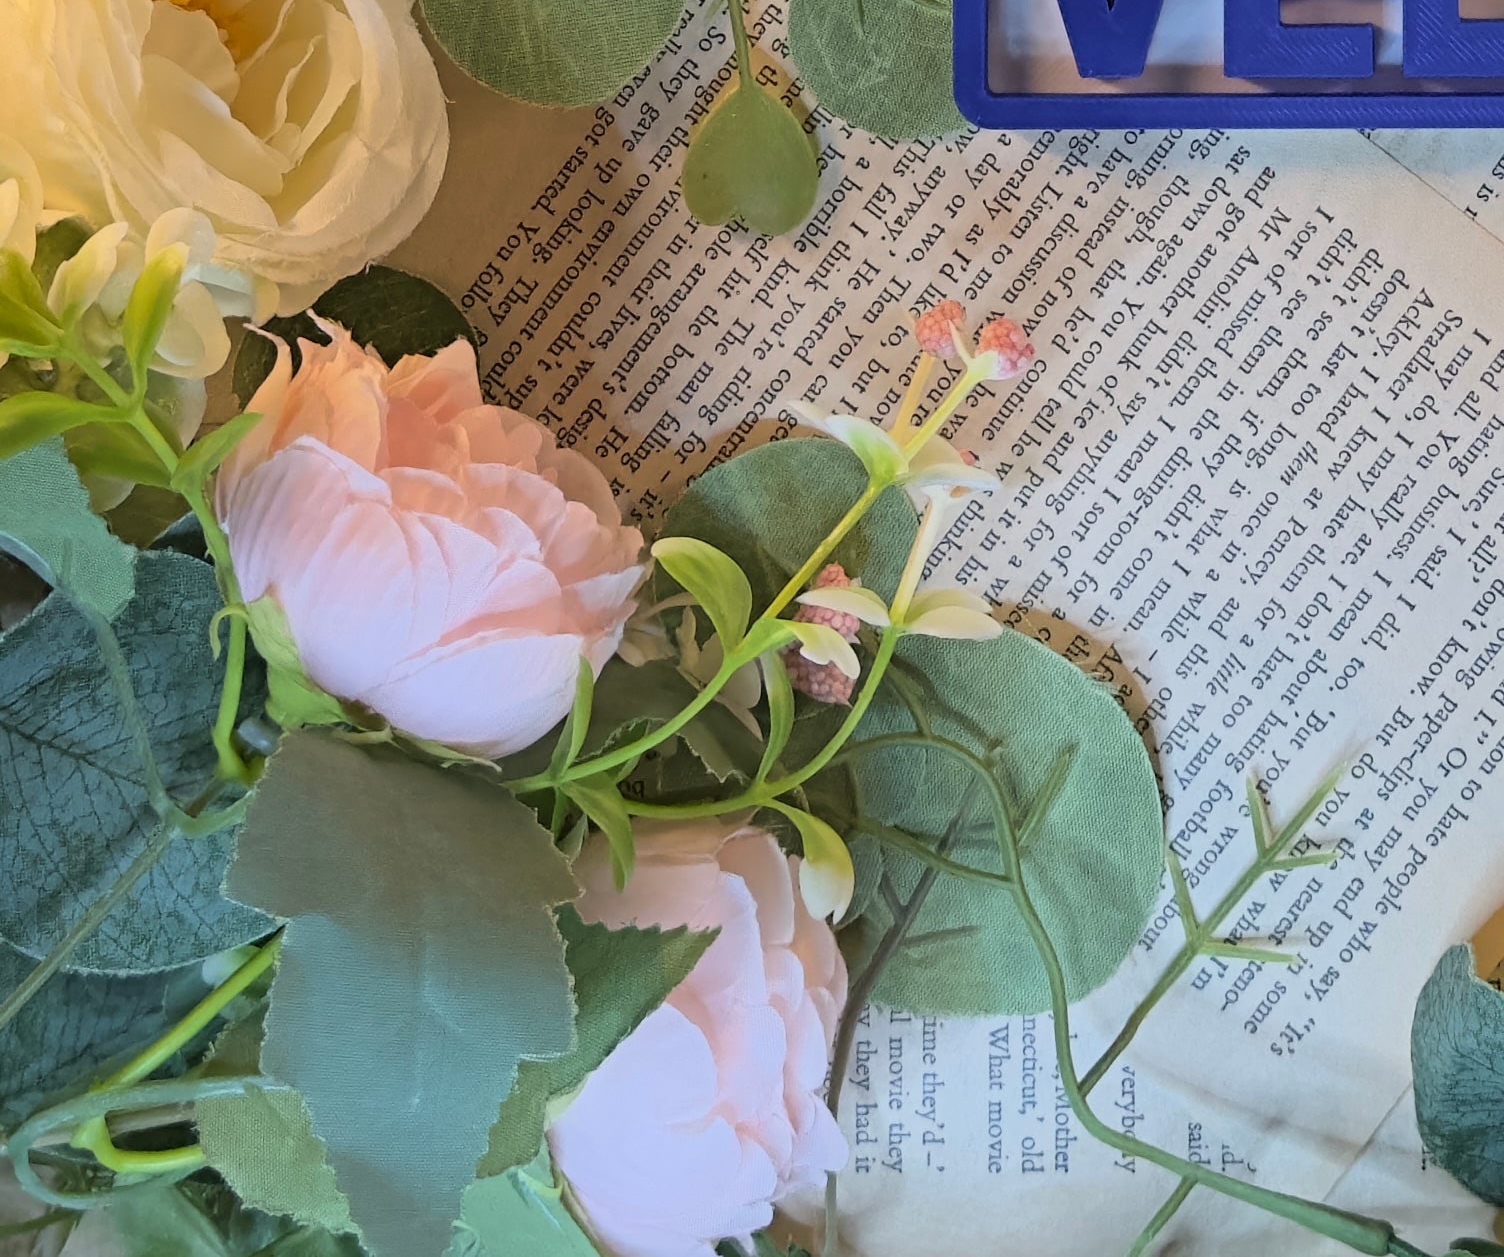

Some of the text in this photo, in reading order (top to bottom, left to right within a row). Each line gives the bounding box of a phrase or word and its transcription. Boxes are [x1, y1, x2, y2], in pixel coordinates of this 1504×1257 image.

[1257, 205, 1292, 242] Mr
[1191, 243, 1260, 329] Antolini
[619, 174, 863, 475] horrible kind. The man falling
[792, 295, 846, 366] started
[827, 274, 912, 369] Then you
[1320, 340, 1358, 378] last
[1115, 391, 1147, 426] say
[1290, 382, 1322, 416] too
[1243, 421, 1297, 469] long,
[1044, 428, 1118, 515] anything
[1174, 308, 1463, 679] Stradlater I knew at Pencey, and this
[1228, 478, 1251, 498] is
[1022, 517, 1055, 552] for
[1185, 507, 1229, 556] what
[1007, 554, 1022, 568] a
[1171, 558, 1191, 577] I
[1122, 576, 1171, 632] mean.
[1459, 778, 1482, 801] to
[1424, 802, 1469, 847] hate
[1374, 844, 1427, 915] people
[1338, 920, 1378, 963] who
[848, 1039, 878, 1173] they had it
[880, 1036, 911, 1173] movie they
[987, 1023, 1011, 1173] What movie
